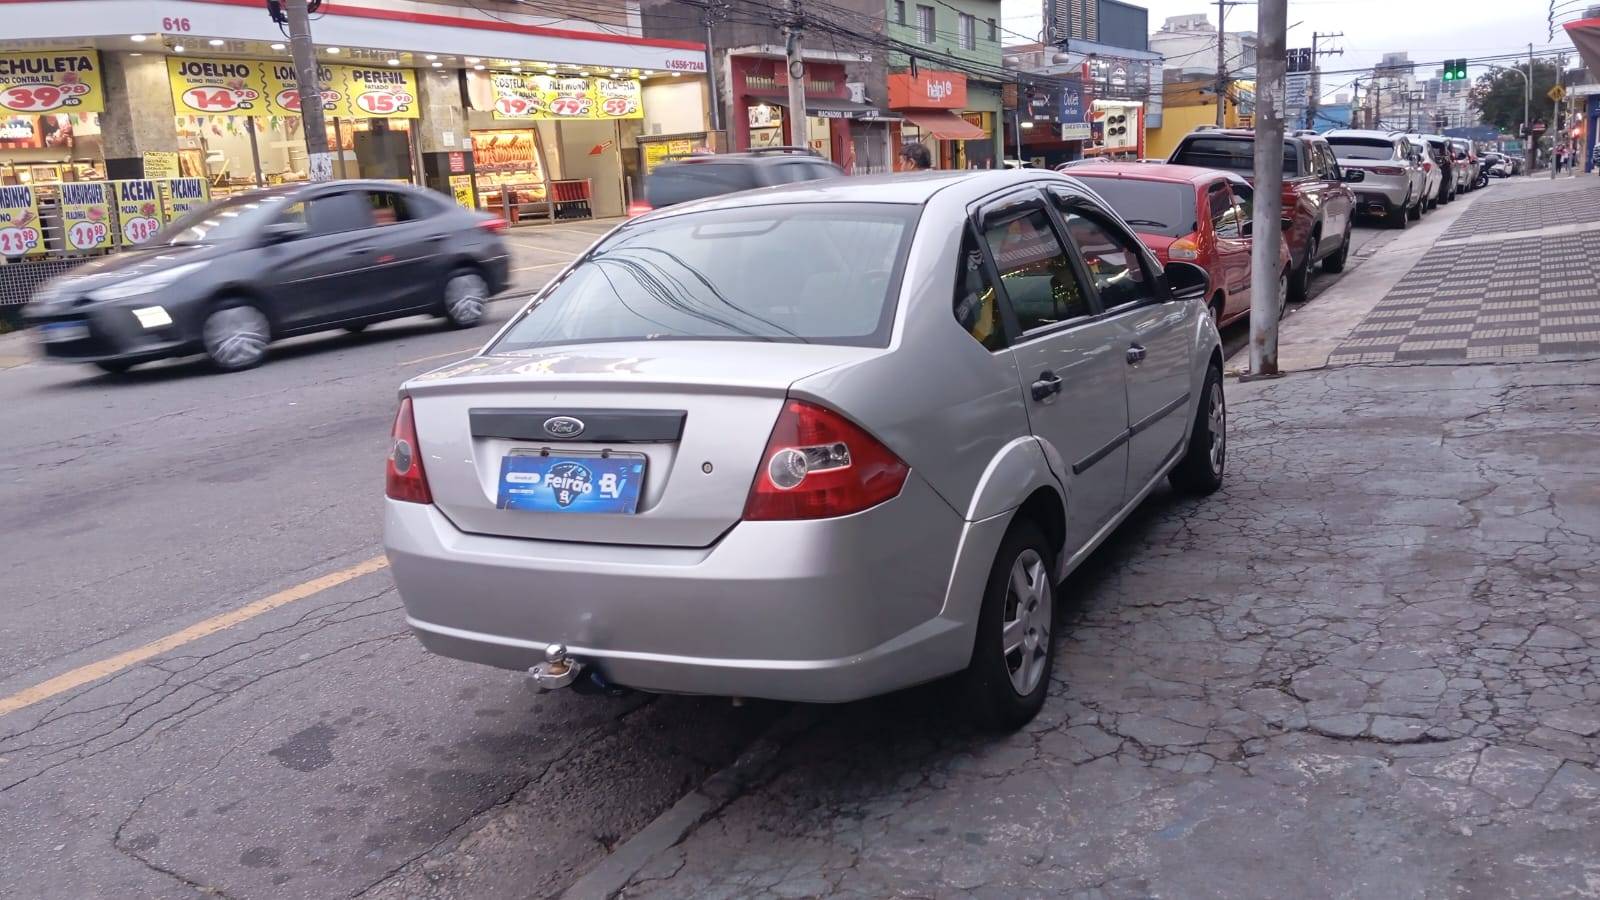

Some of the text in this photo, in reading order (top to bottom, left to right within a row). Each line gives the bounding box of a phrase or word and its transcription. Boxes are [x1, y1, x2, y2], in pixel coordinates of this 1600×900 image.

[162, 17, 191, 32] 616
[0, 56, 93, 75] CHULETA
[178, 62, 250, 78] JOELHO
[352, 70, 407, 85] PERNIL
[495, 77, 526, 90] COSTELA
[8, 87, 61, 109] 39
[190, 90, 236, 109] 14
[363, 95, 394, 111] 15
[500, 98, 527, 113] 19
[553, 99, 580, 113] 79
[606, 98, 627, 113] 59
[121, 180, 156, 202] ACEM
[170, 179, 203, 199] PICANHA
[132, 222, 147, 240] 38
[551, 420, 574, 433] Ford
[544, 473, 593, 494] Feirão
